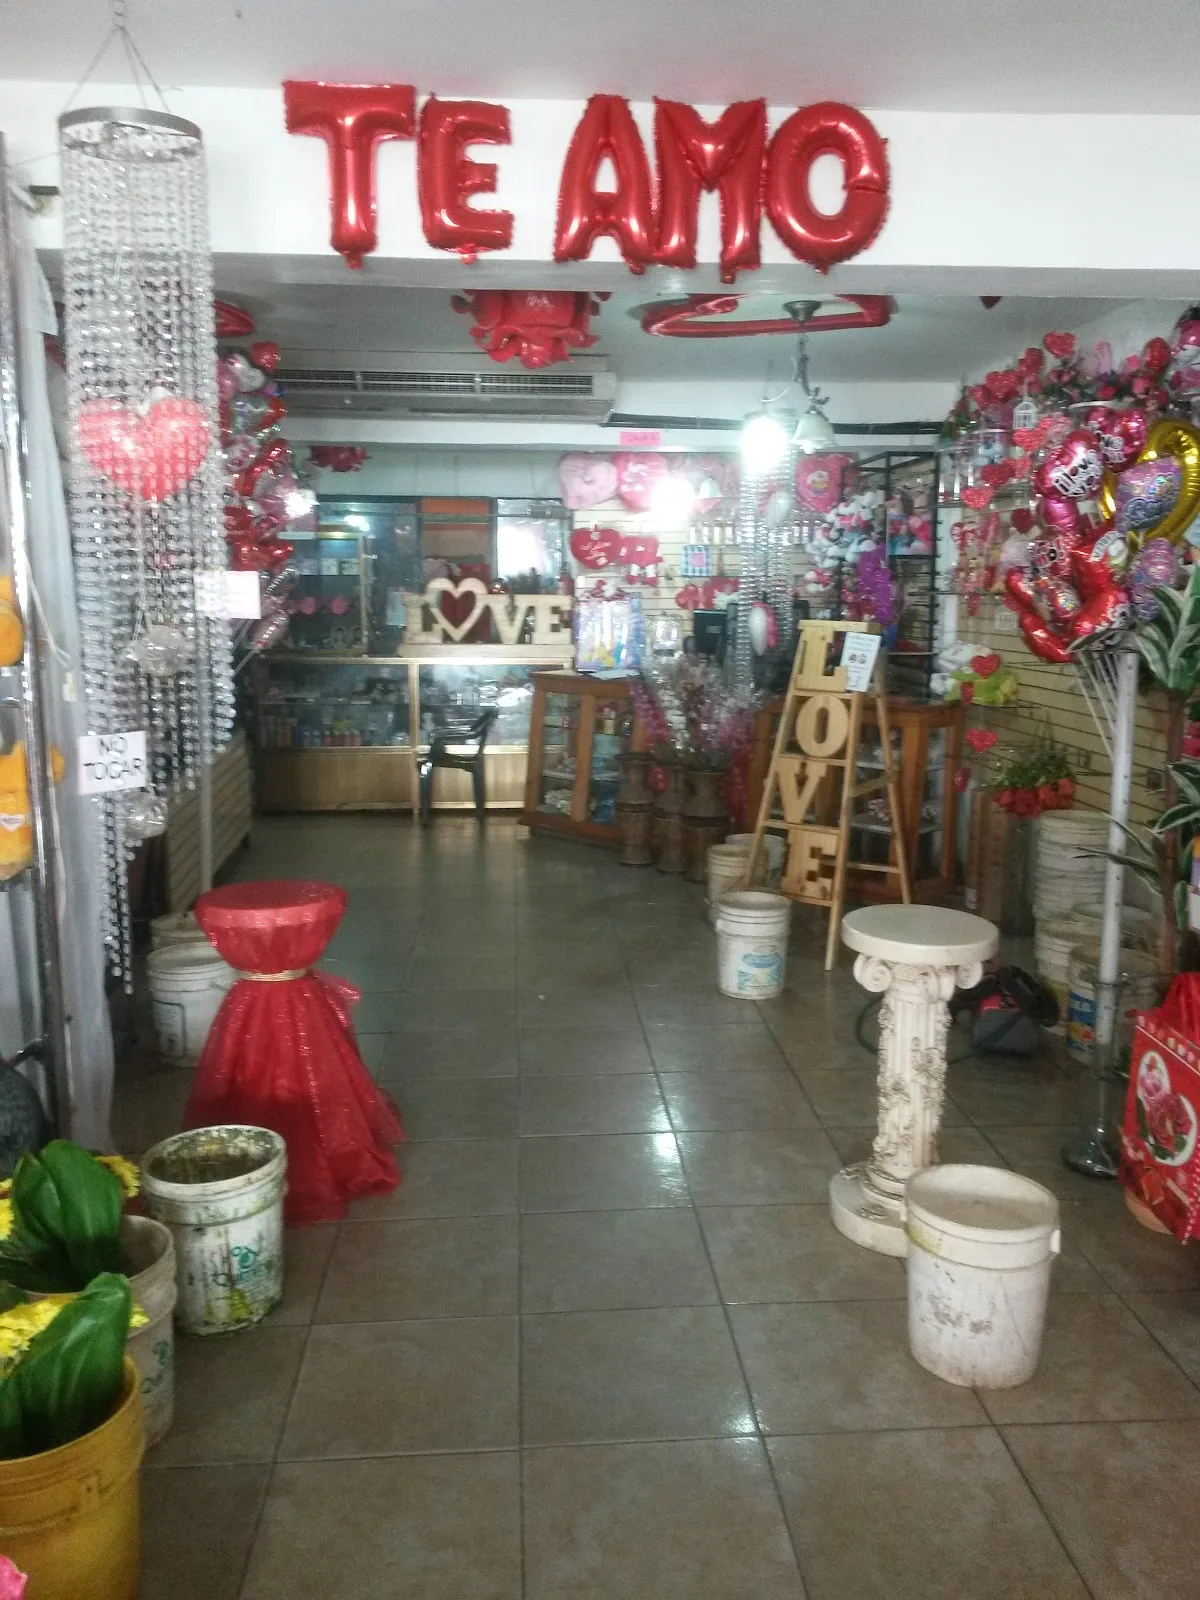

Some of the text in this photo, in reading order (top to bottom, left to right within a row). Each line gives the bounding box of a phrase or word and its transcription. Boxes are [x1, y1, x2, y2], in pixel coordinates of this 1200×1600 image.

[282, 80, 892, 283] TE AMO
[99, 736, 128, 756] NO
[774, 627, 851, 901] LOVE
